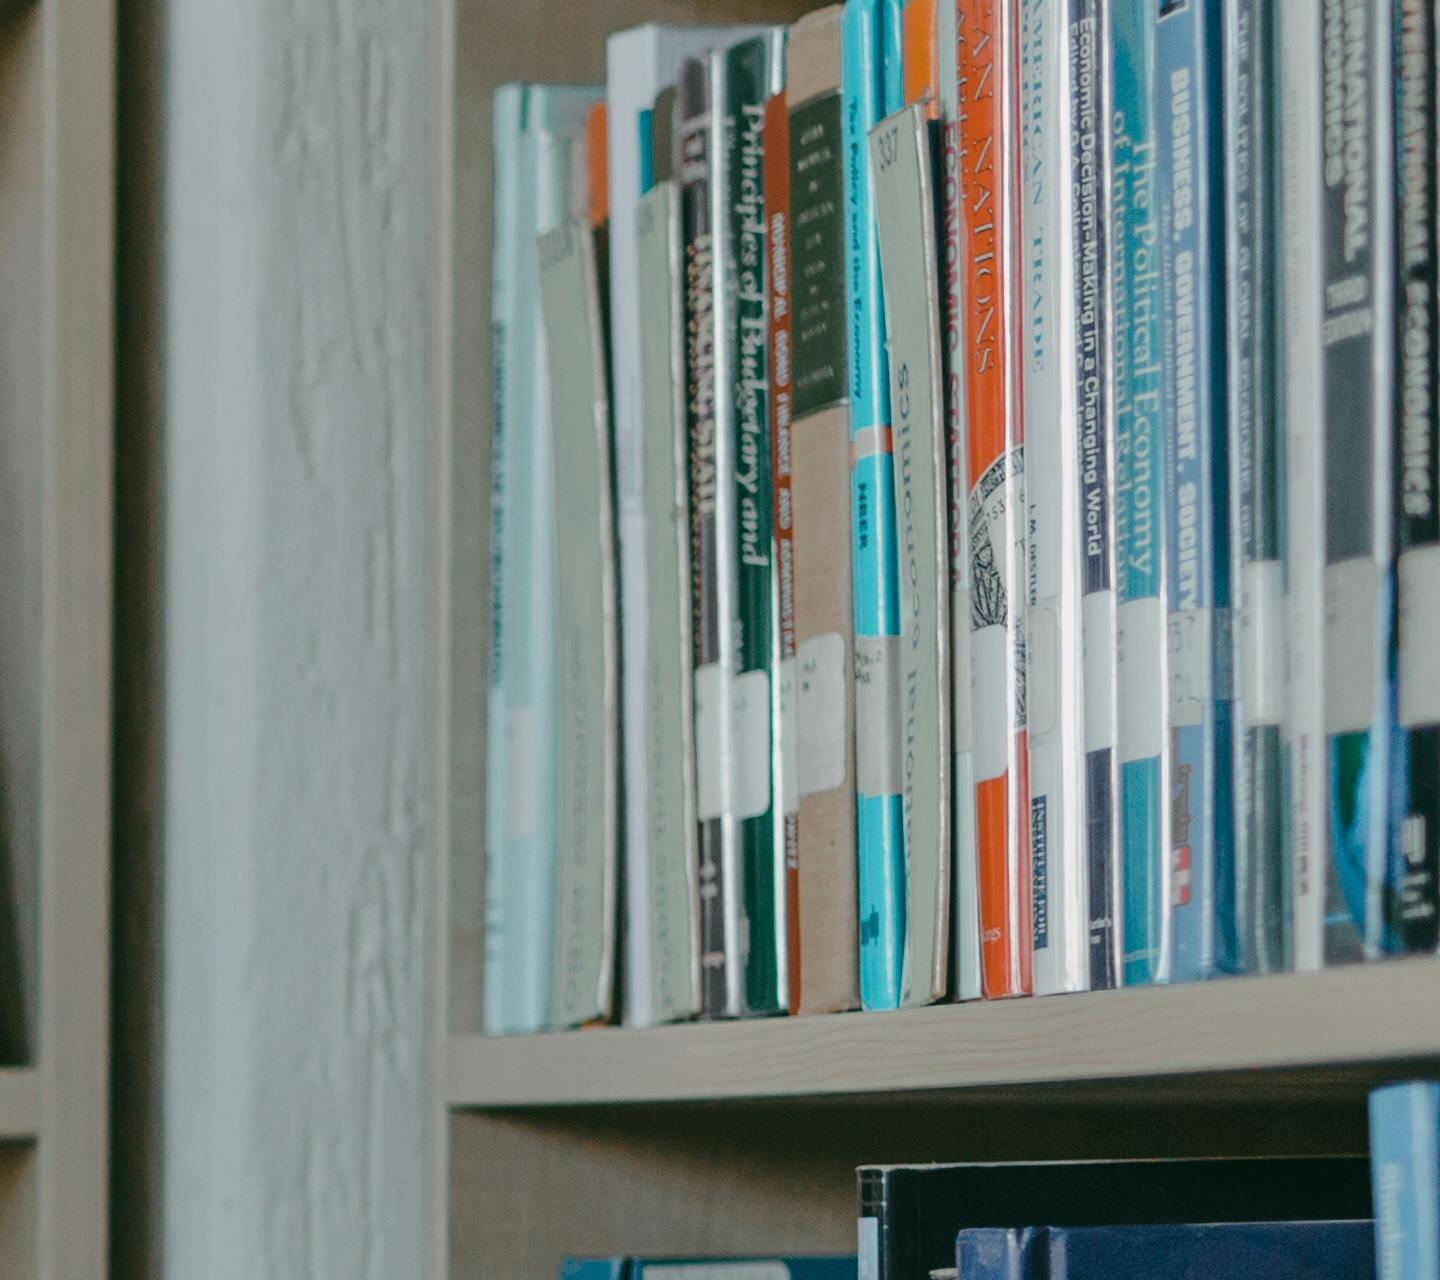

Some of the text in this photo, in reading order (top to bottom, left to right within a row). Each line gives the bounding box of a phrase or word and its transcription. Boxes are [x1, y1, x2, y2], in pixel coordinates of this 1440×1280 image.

[1079, 16, 1097, 129] Economic
[972, 136, 996, 376] NATIONS
[1081, 132, 1100, 324] Decision-Making
[735, 103, 768, 565] Principles of Budgetary and
[1084, 329, 1100, 351] in
[1128, 134, 1163, 576] The Political Economy
[1174, 252, 1196, 473] GOVERNMENT,
[1082, 376, 1101, 485] Changing
[1087, 490, 1102, 557] World
[1178, 482, 1199, 612] SOCIETY
